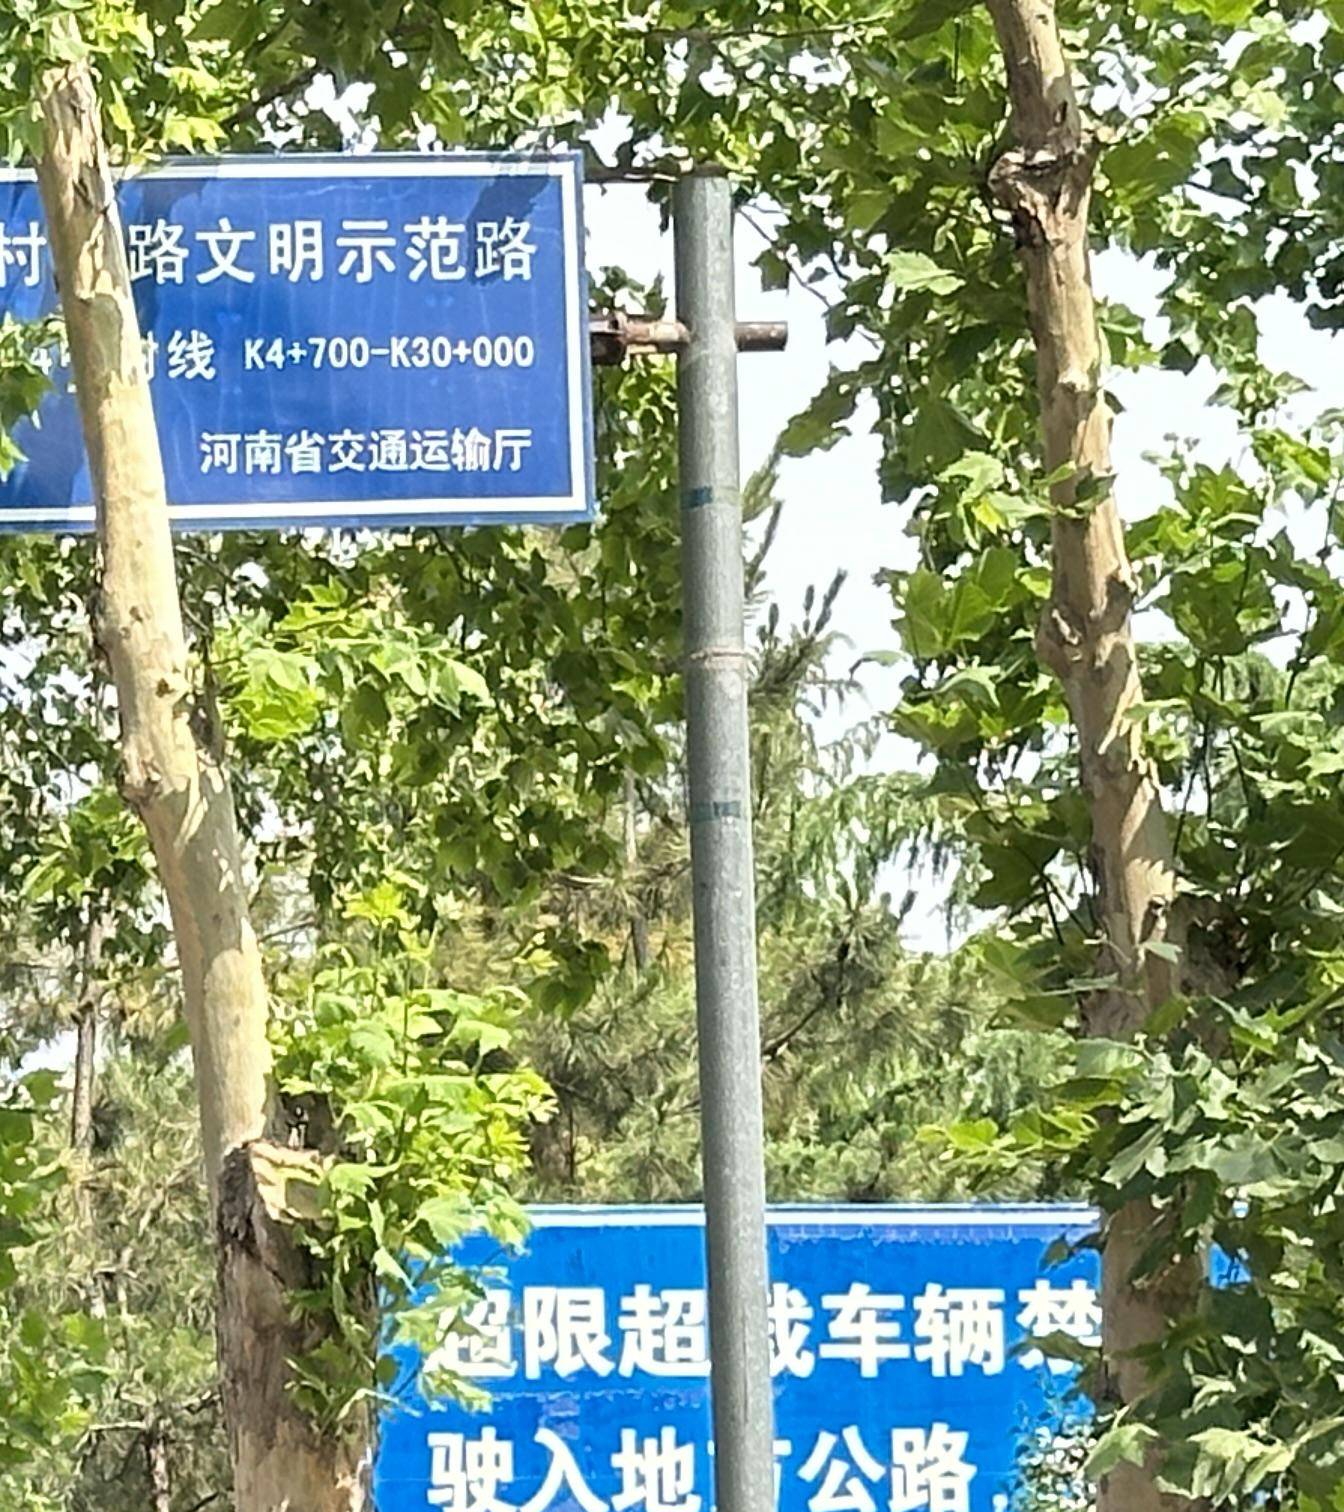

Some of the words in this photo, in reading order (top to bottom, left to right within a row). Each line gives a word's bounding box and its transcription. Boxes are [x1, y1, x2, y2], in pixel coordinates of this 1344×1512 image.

[244, 336, 535, 371] K4+700-K30+000
[200, 427, 532, 475] 河南省交通运输厅
